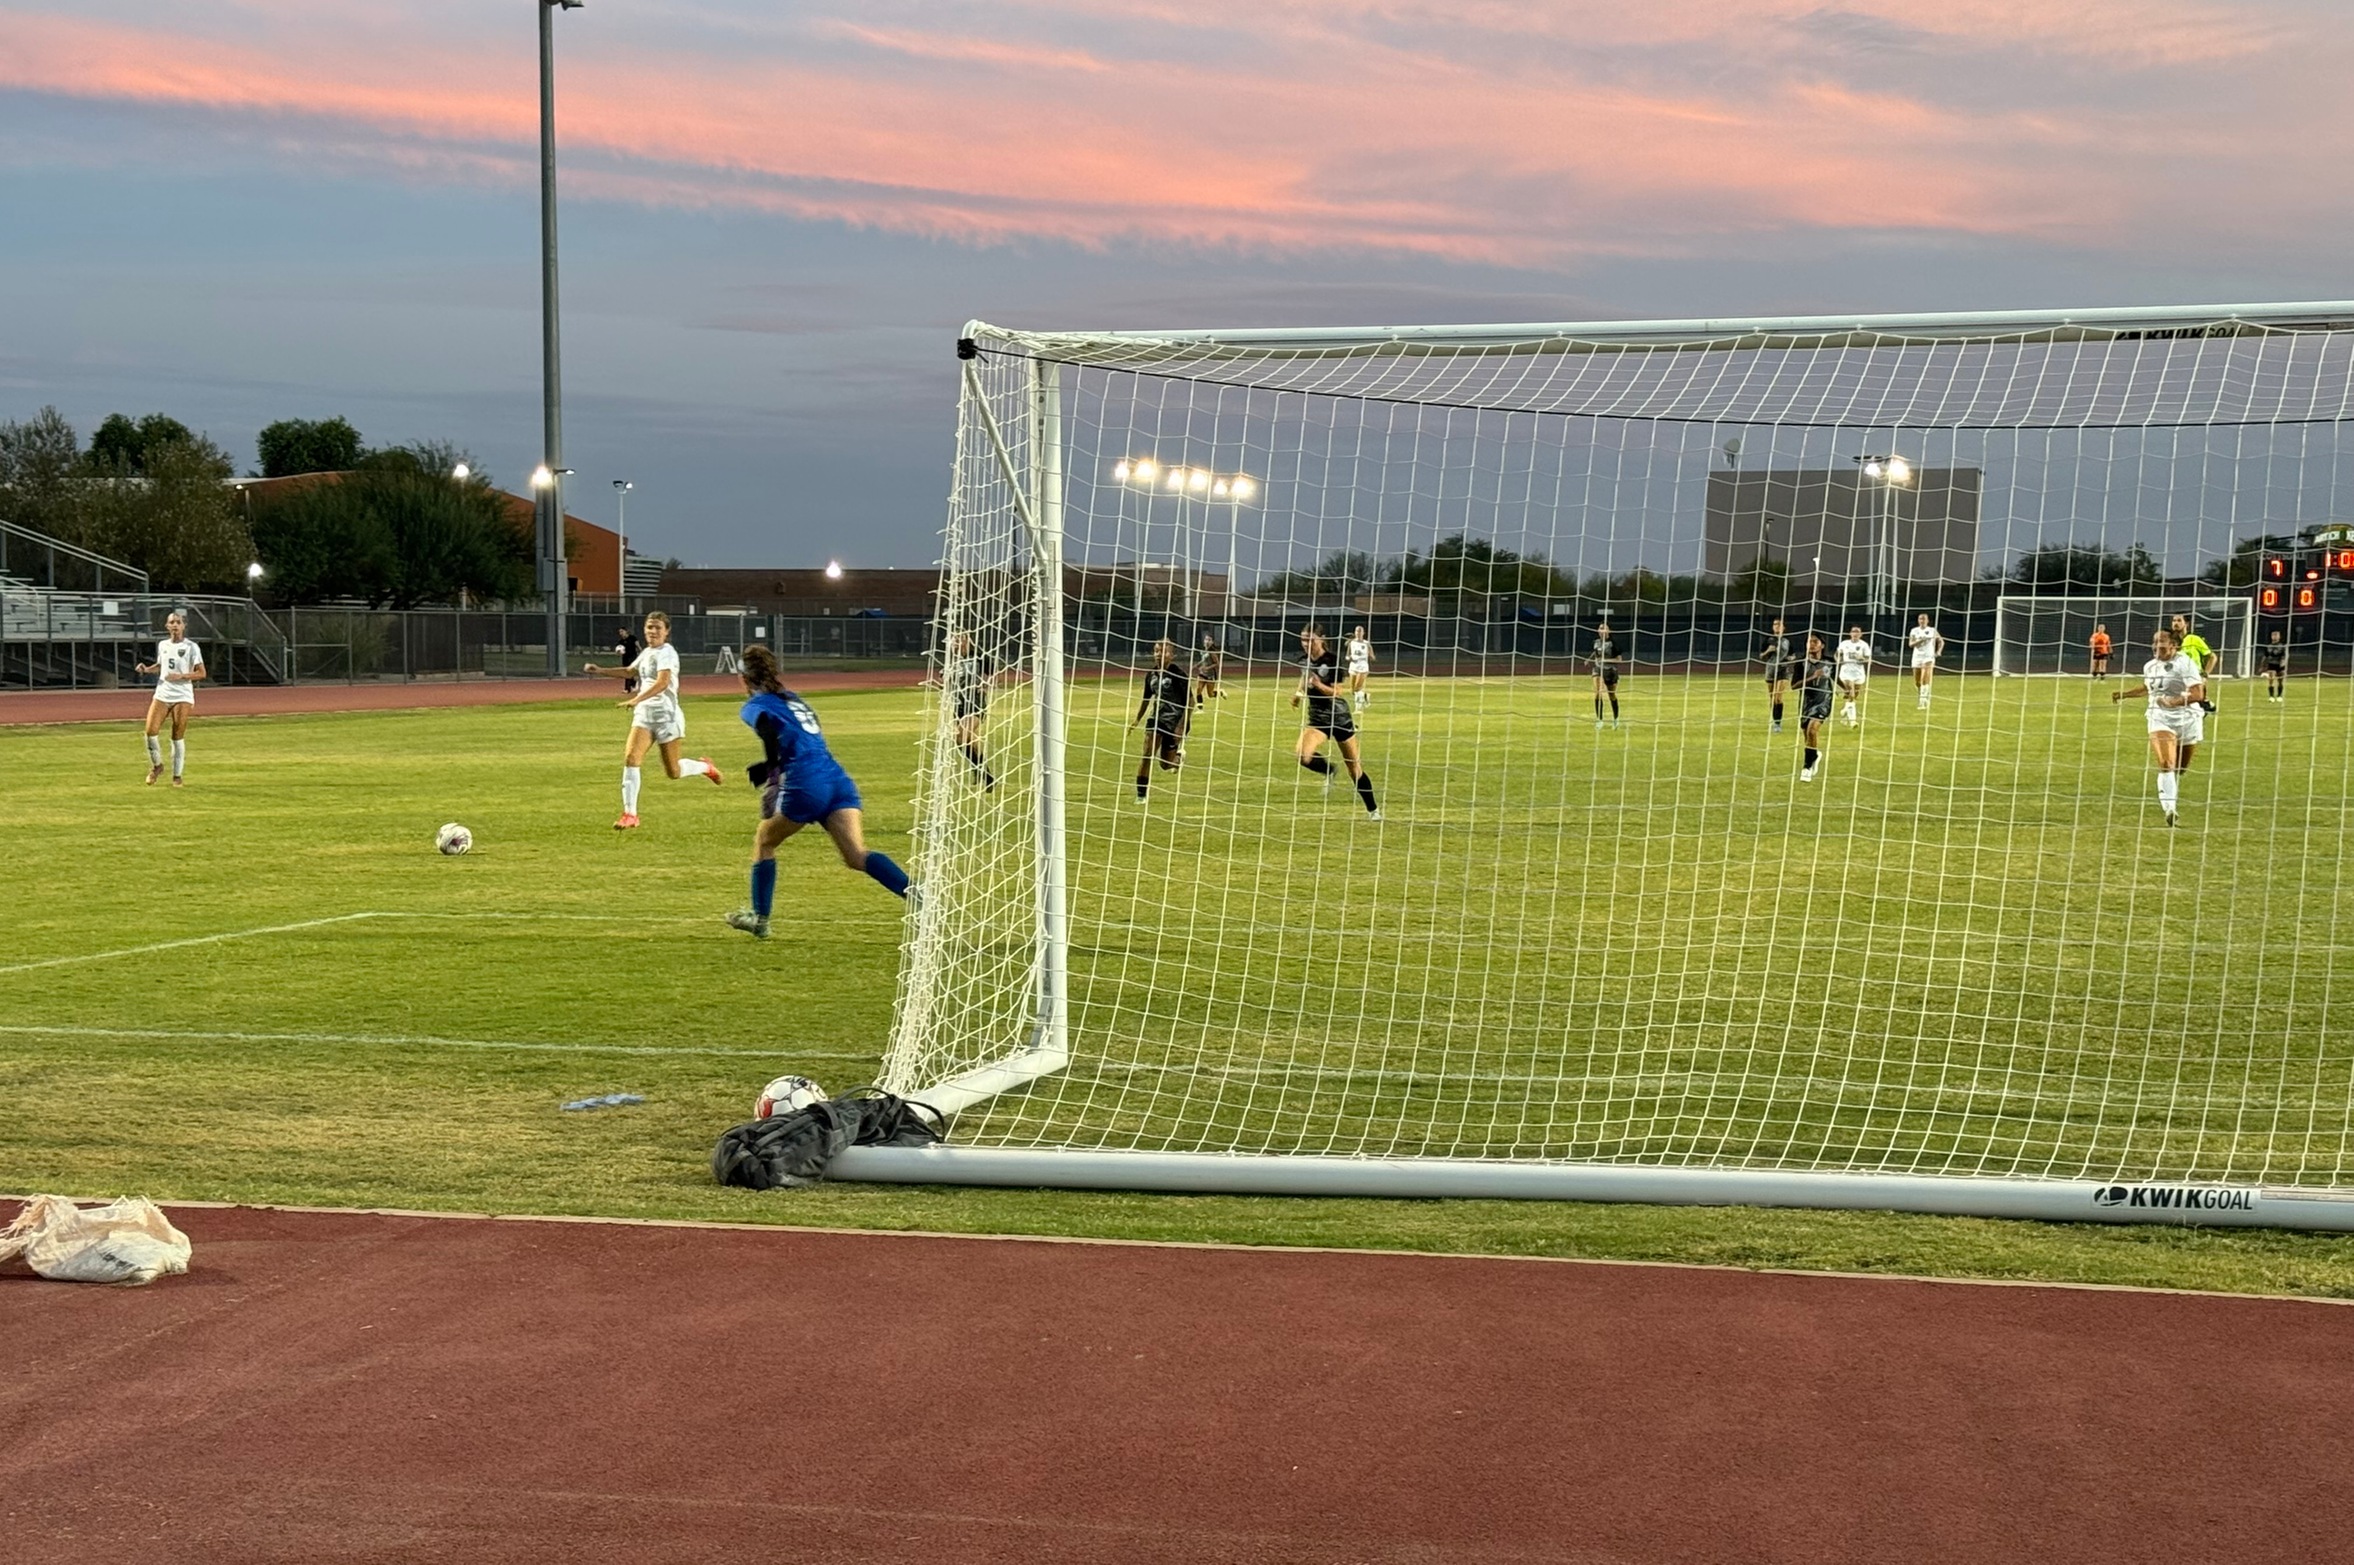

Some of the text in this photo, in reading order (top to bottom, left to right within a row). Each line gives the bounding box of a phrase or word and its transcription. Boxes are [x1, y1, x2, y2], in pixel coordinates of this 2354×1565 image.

[2263, 589, 2275, 607] 0
[2300, 589, 2313, 607] 0
[168, 657, 176, 670] 5
